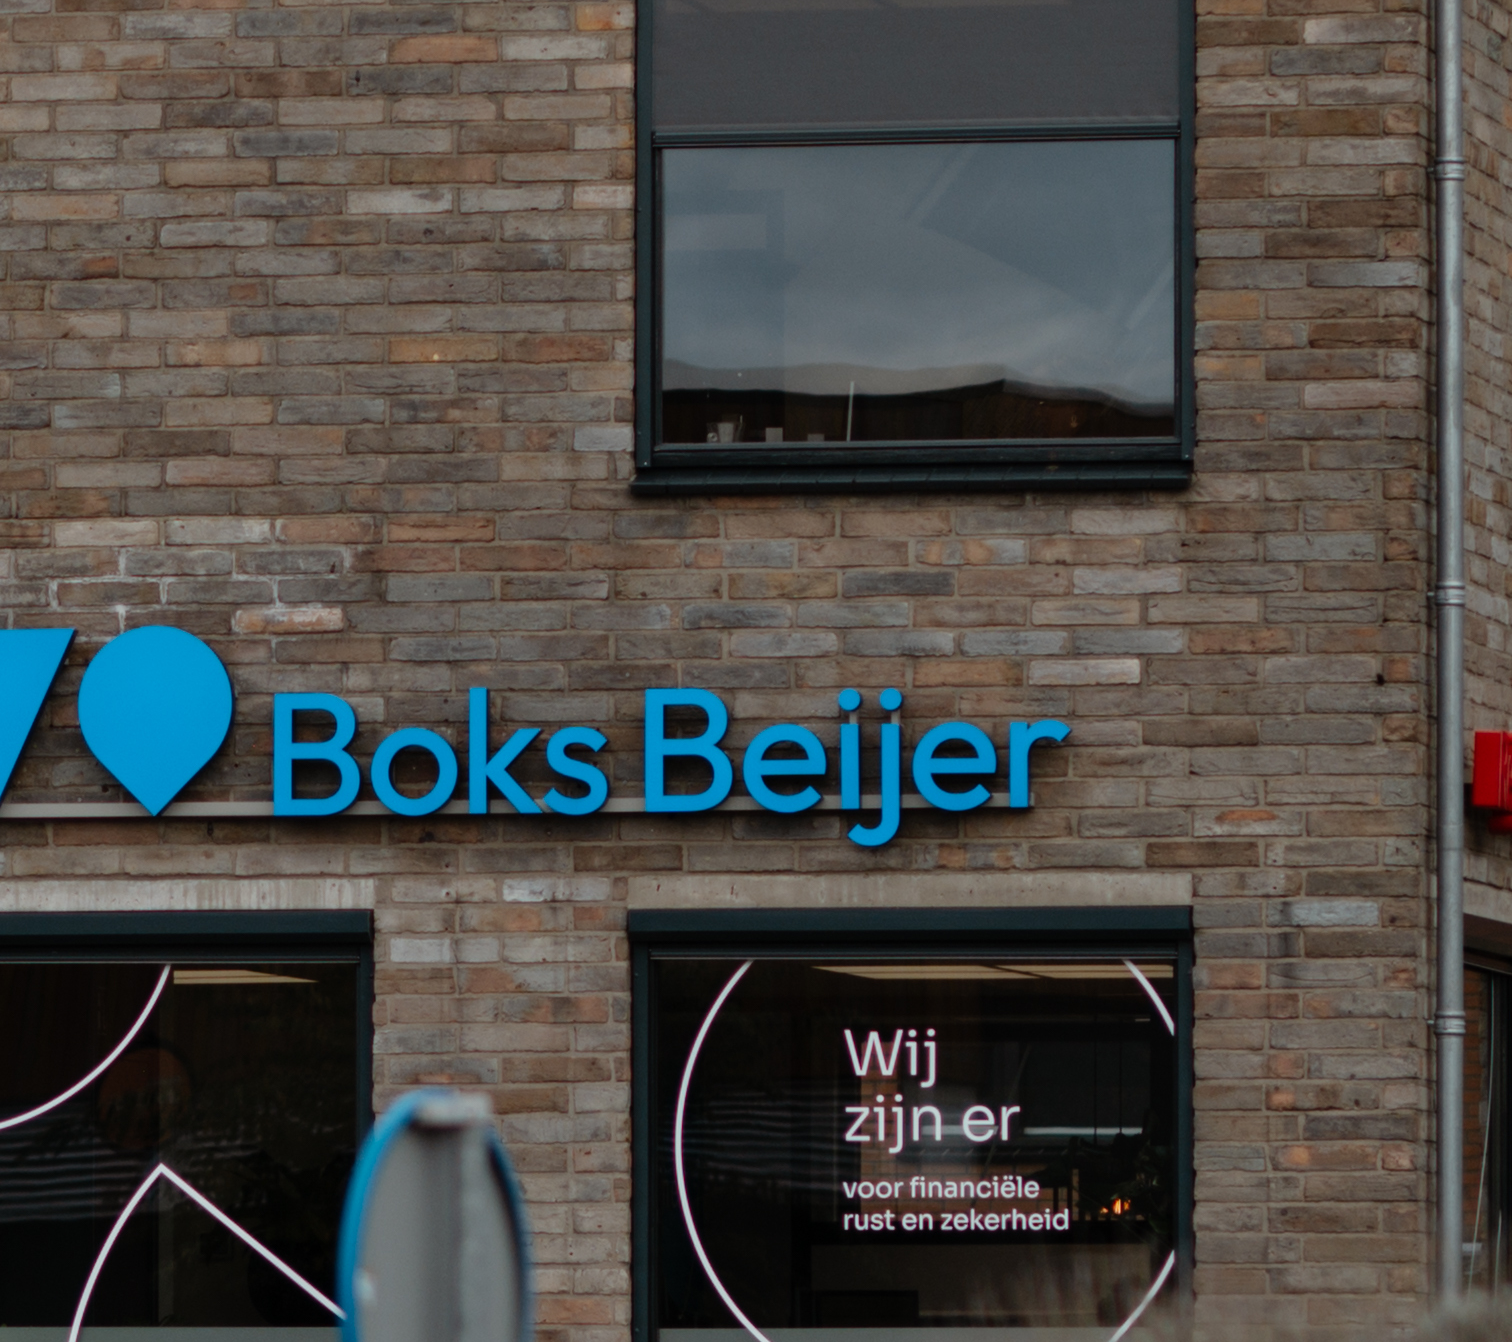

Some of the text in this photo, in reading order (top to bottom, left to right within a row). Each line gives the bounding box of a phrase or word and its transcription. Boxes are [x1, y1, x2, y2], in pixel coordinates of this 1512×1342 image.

[272, 686, 1074, 848] Boks Beijer
[843, 1028, 938, 1088] Wij
[844, 1094, 1022, 1154] zijn er
[842, 1176, 1040, 1199] voor financiële
[842, 1208, 1070, 1232] rust en zekerheid
